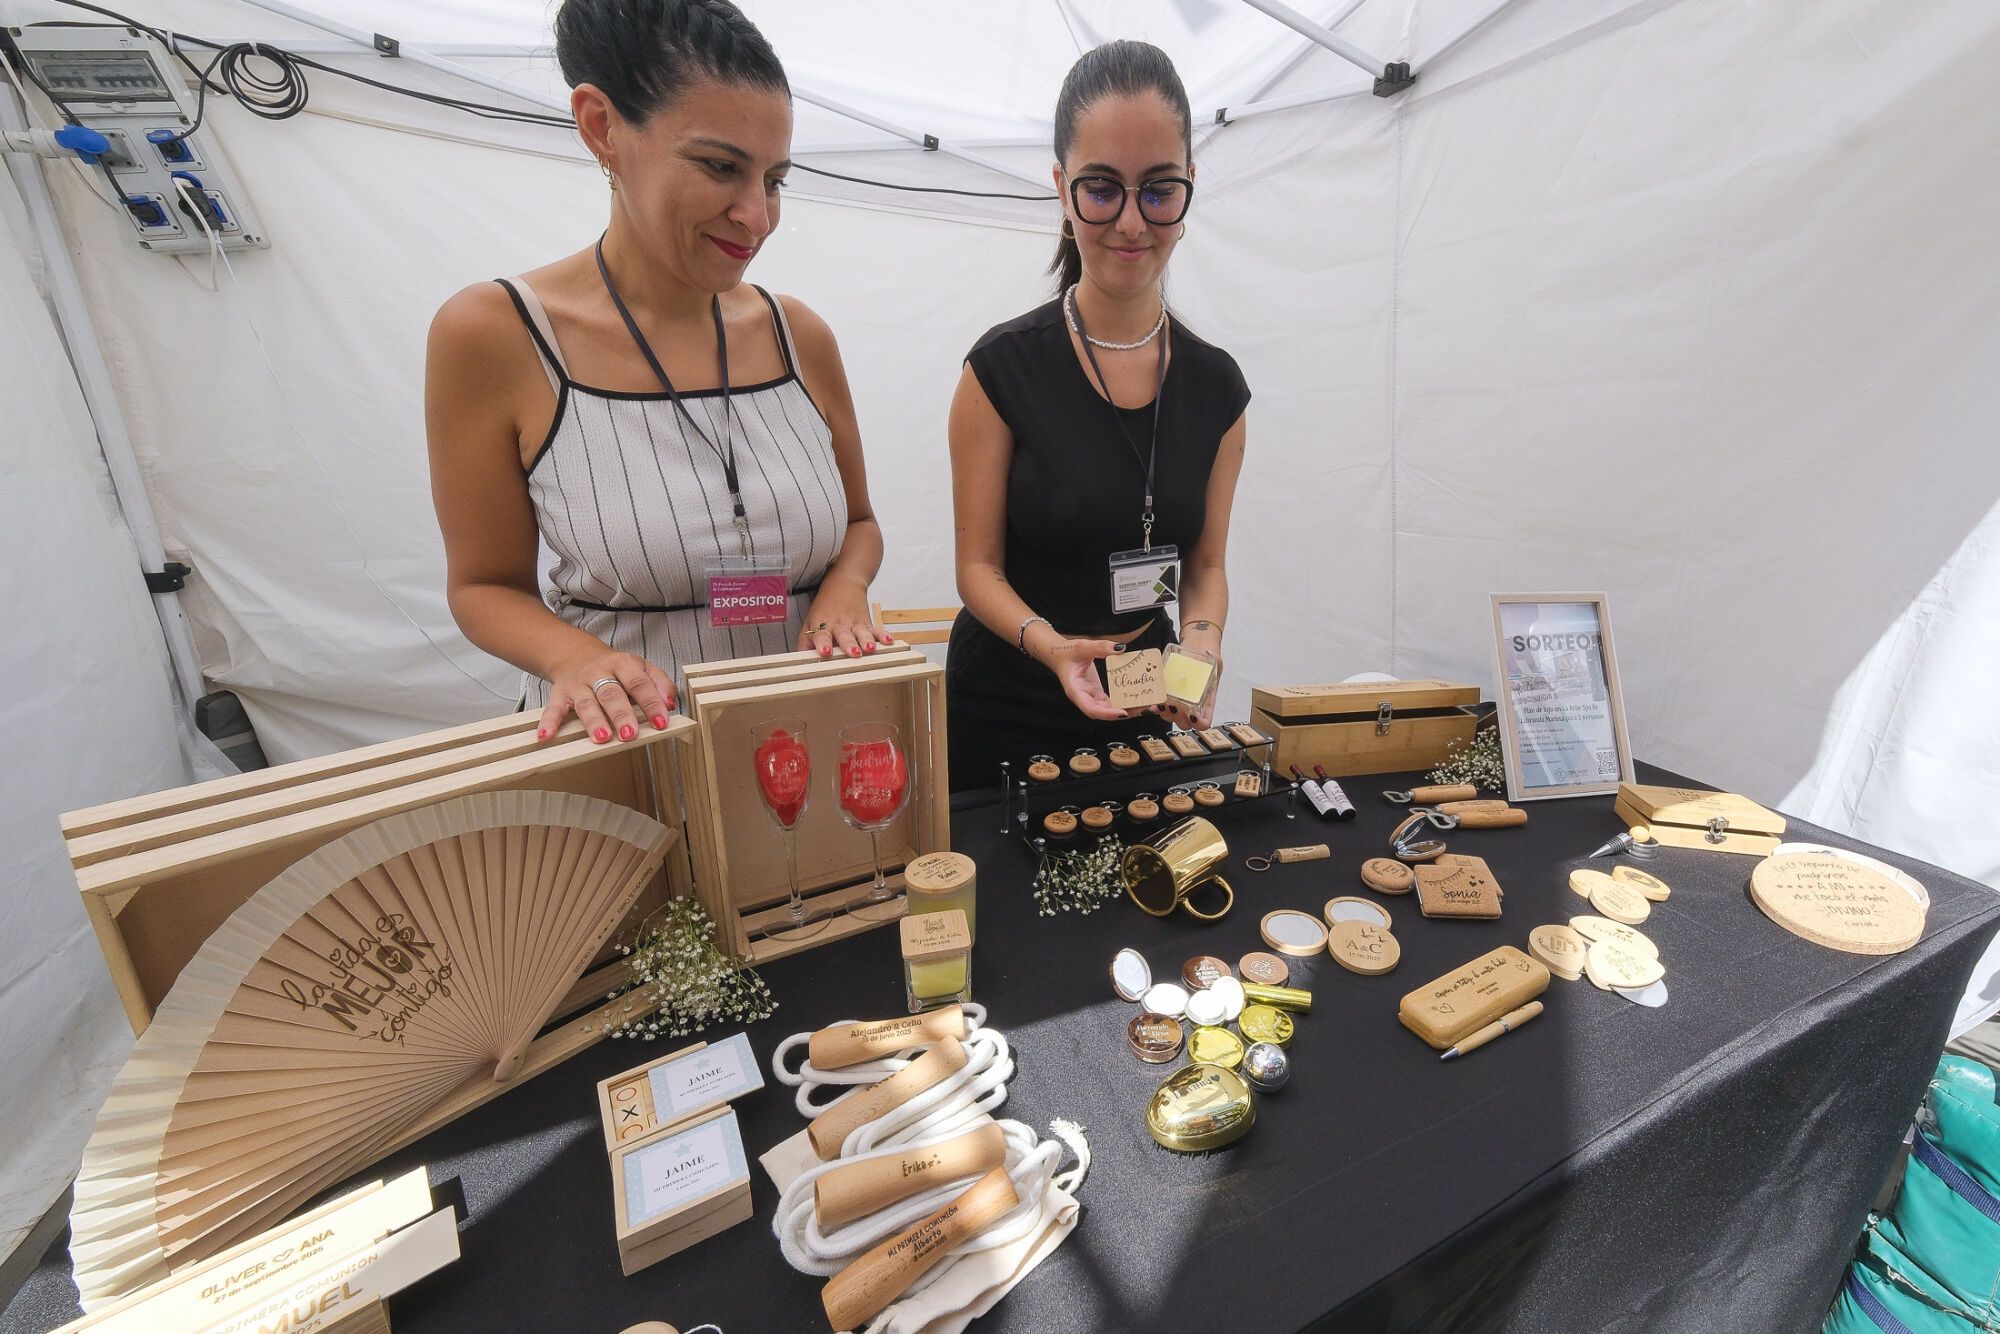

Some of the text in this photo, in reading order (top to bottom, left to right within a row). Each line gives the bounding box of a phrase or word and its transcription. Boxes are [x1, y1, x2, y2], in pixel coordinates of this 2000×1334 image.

[713, 595, 784, 608] EXPOSITOR
[1115, 673, 1155, 687] Claudia
[1441, 886, 1481, 898] Sonia
[330, 913, 405, 979] vida es
[322, 926, 436, 1031] MEJOR
[281, 979, 335, 1011] la
[380, 962, 453, 1042] contigo
[850, 1024, 892, 1038] Alejandro
[901, 1019, 922, 1028] Celia
[896, 1028, 912, 1036] 2025
[688, 1066, 723, 1086] JAIME
[665, 1154, 705, 1179] JAIME
[902, 1160, 927, 1177] Érika
[888, 1247, 898, 1258] MI
[897, 1229, 925, 1251] PRIMERA
[913, 1229, 942, 1254] Alberto
[201, 1229, 335, 1300] OLIVER ANA
[243, 1258, 299, 1290] septiembre
[301, 1246, 324, 1261] 2025
[295, 1252, 379, 1300] COMUNIÓN
